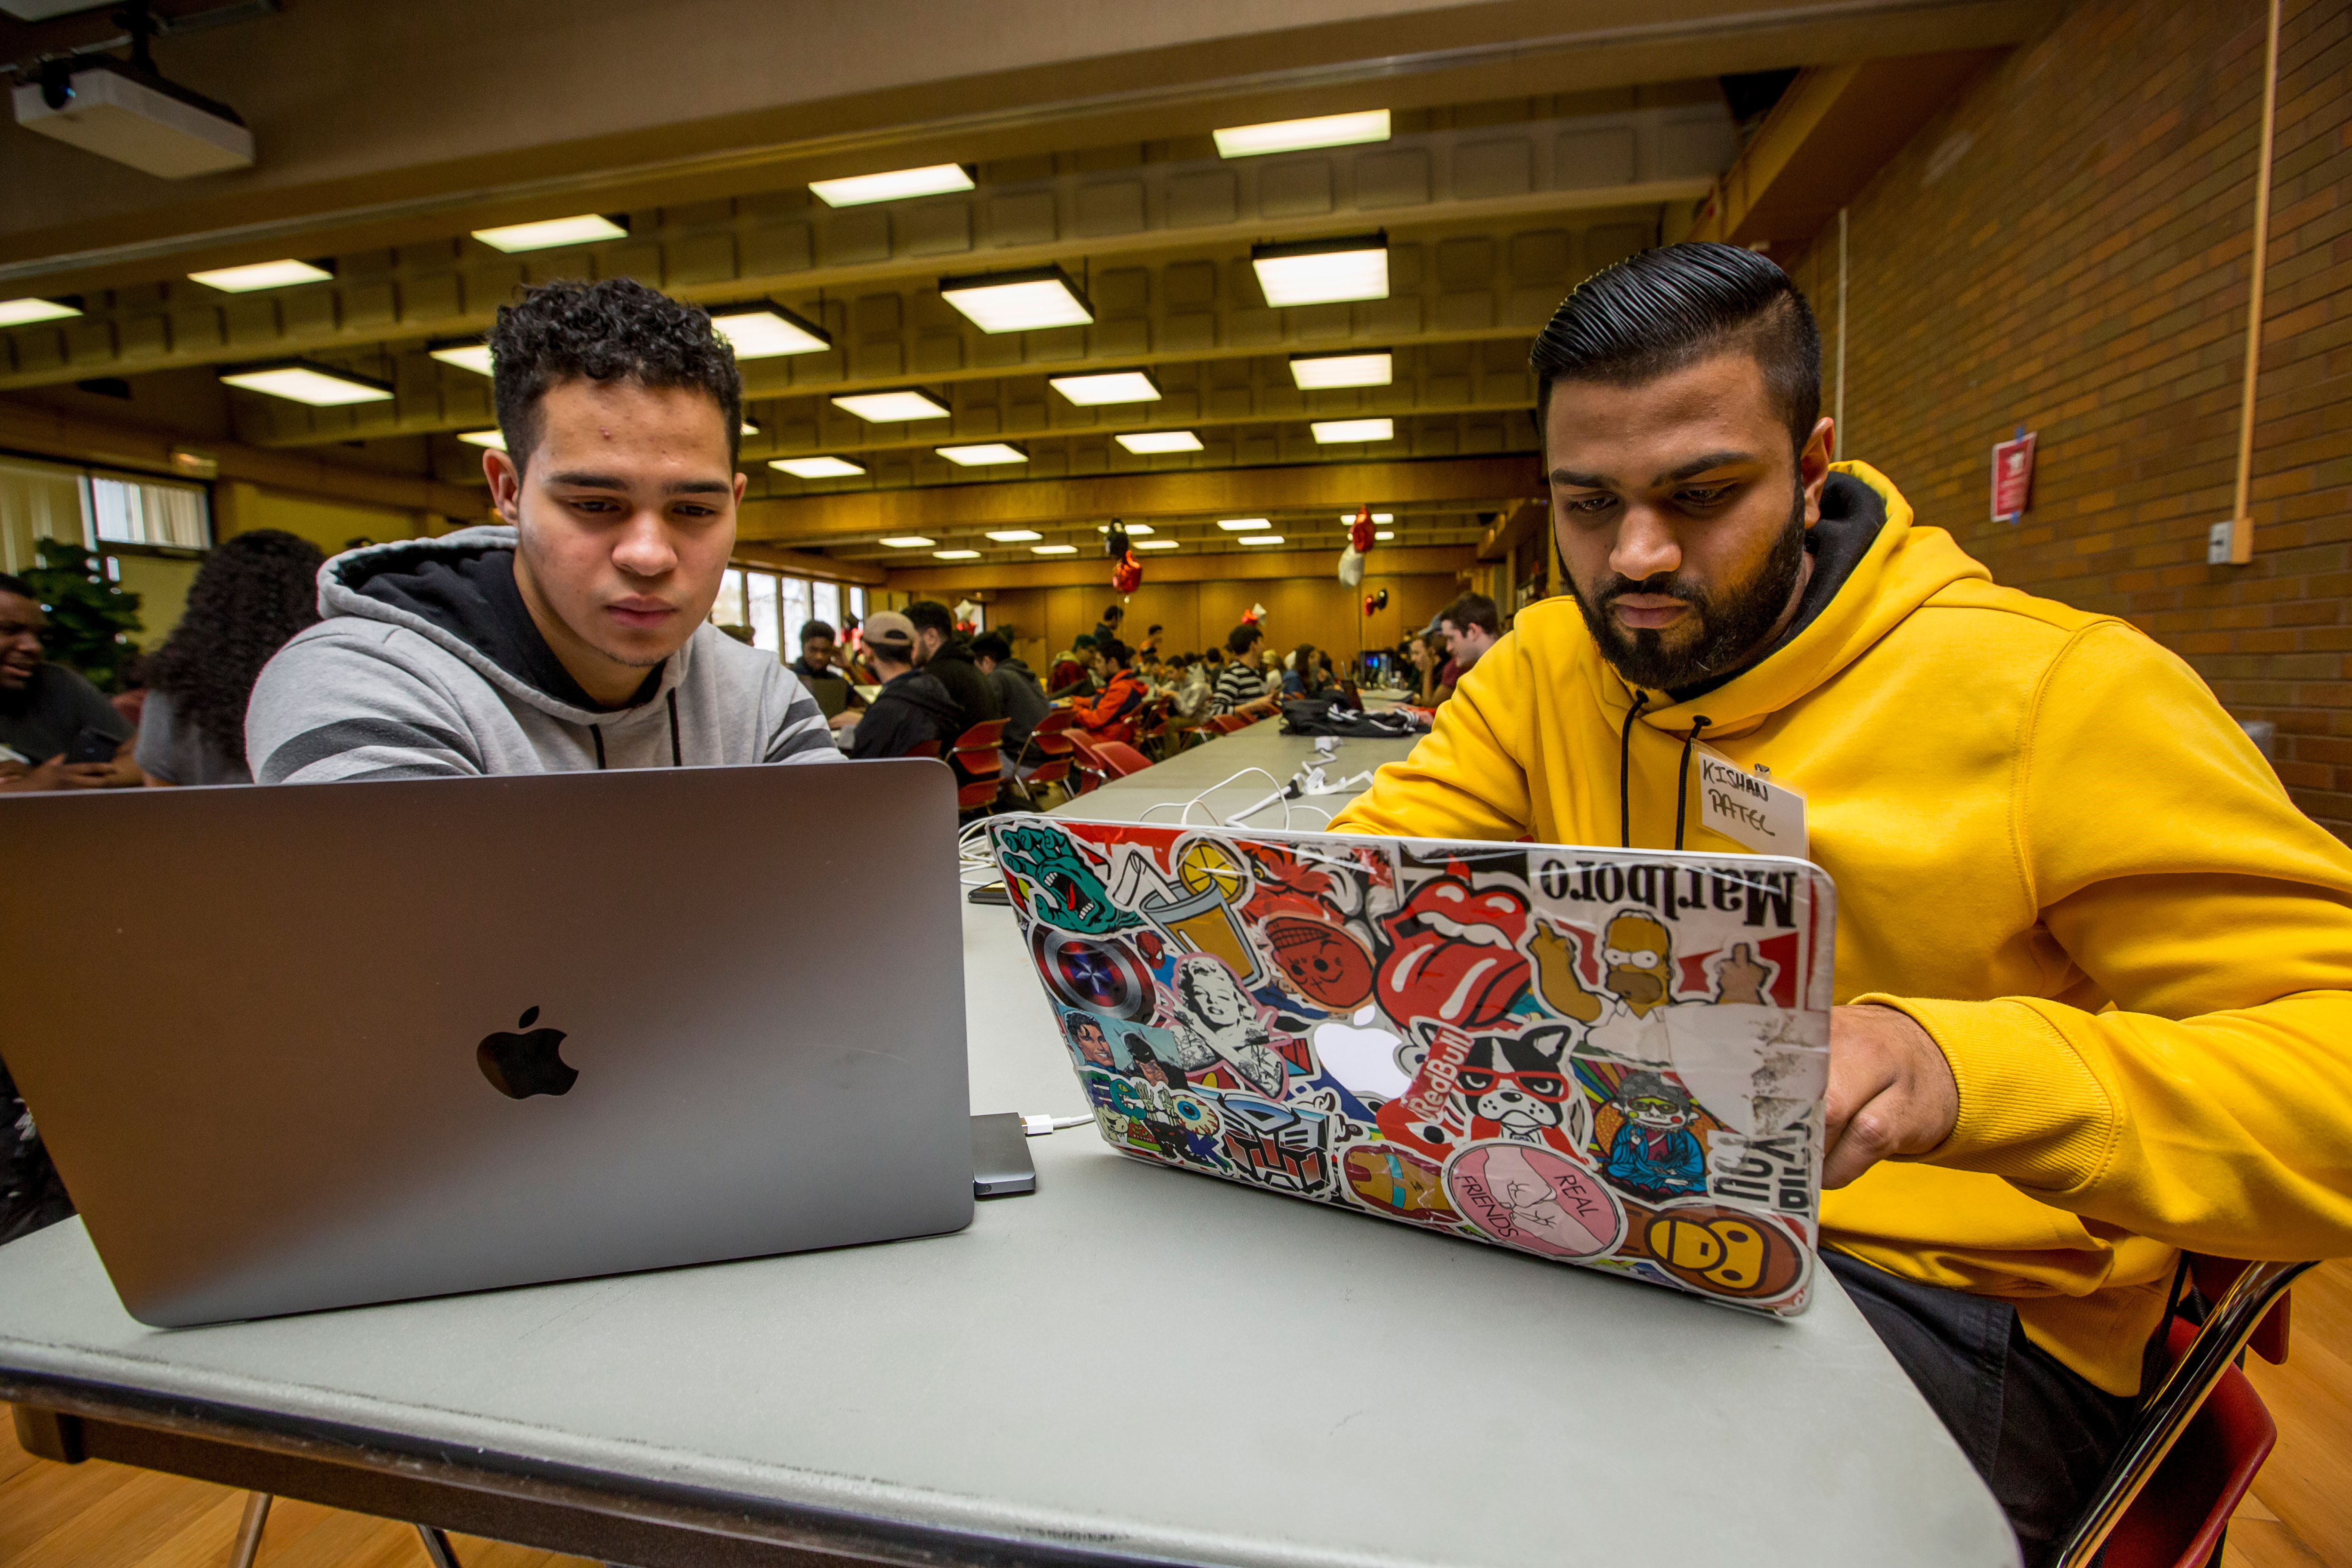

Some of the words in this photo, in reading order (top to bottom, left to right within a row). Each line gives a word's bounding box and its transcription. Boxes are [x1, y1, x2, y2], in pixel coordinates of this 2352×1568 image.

[1708, 788, 1775, 836] PATEL
[1541, 859, 1797, 928] Marlboro
[1455, 1176, 1519, 1238] FRIENDS
[1554, 1175, 1599, 1218] REAL
